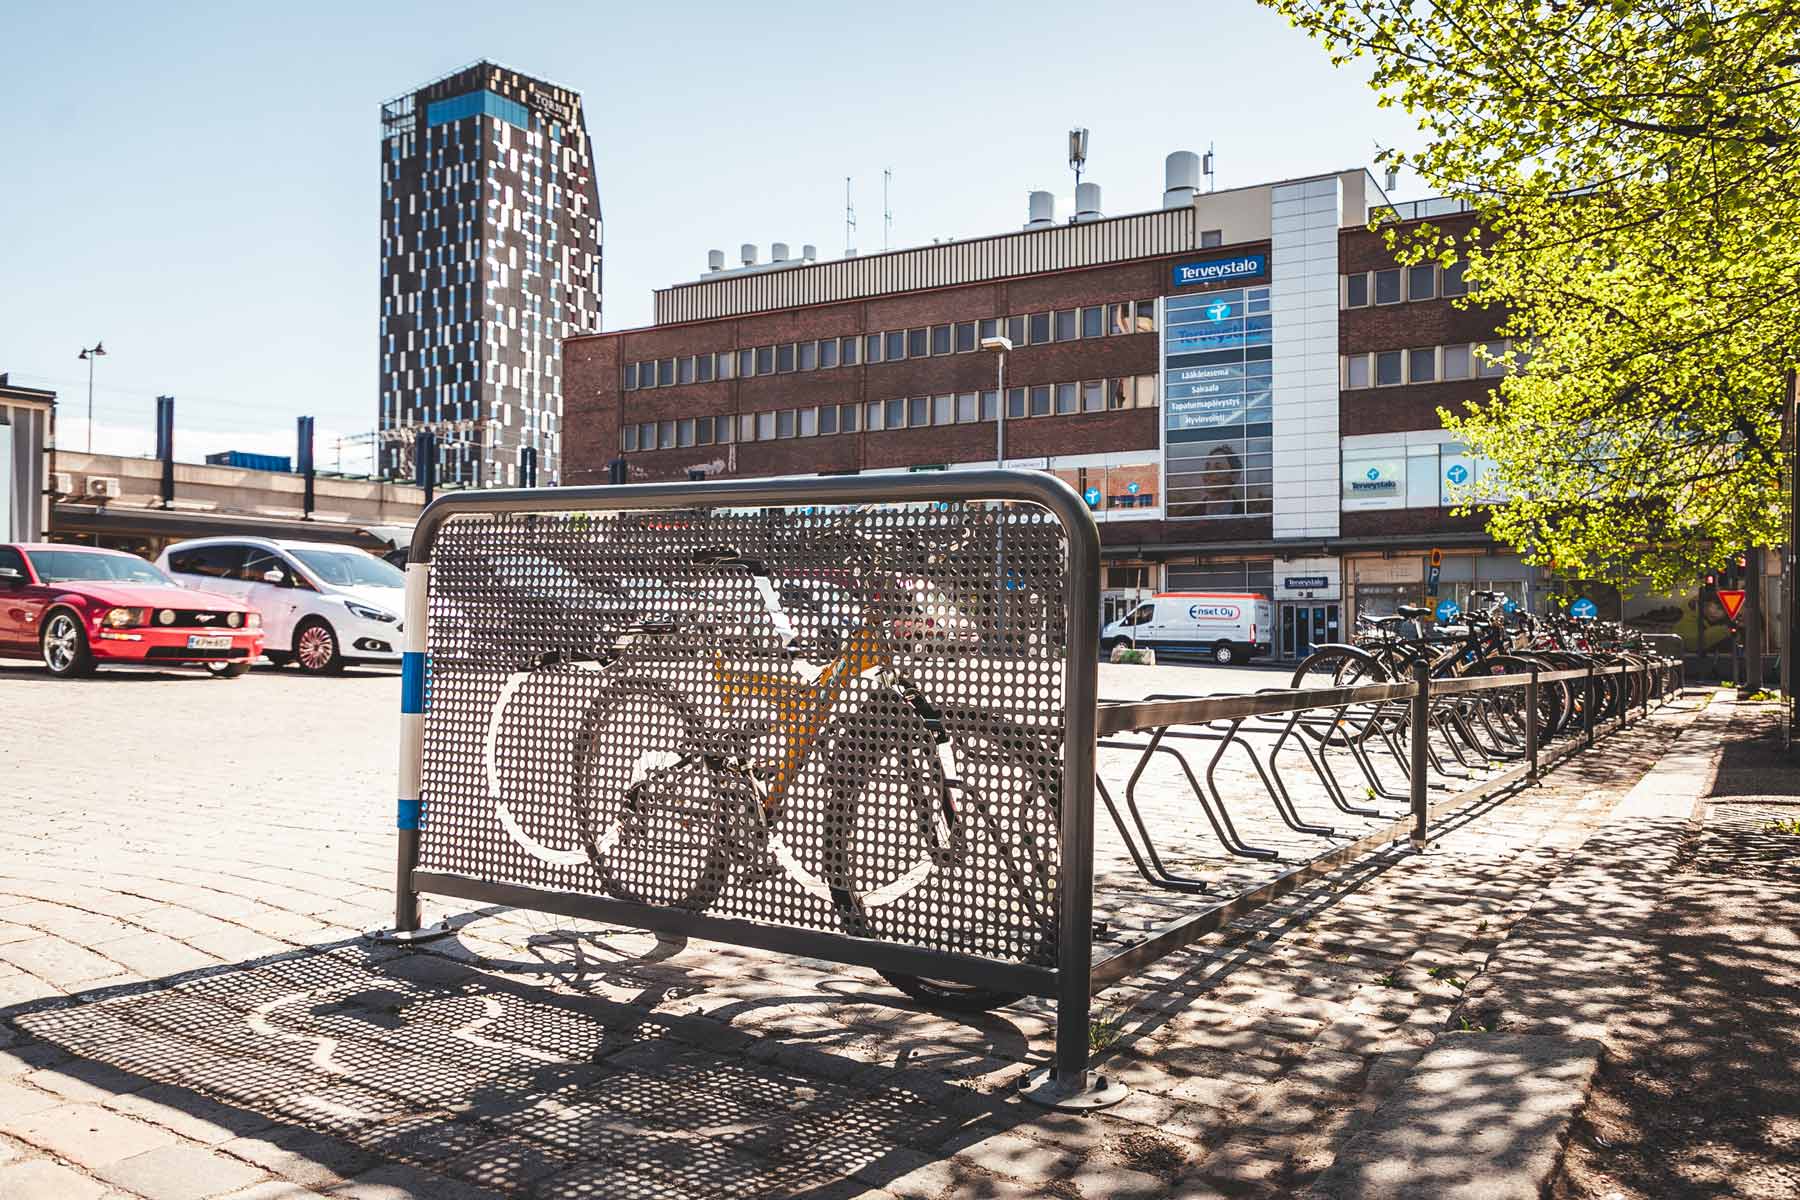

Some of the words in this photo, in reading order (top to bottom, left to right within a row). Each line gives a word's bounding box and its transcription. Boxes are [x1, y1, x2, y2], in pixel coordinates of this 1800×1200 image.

[1180, 259, 1257, 279] Terveystalo
[1191, 383, 1220, 394] Sairaala
[1352, 480, 1397, 490] Terveystalo
[1189, 604, 1217, 620] Enset
[1220, 607, 1233, 617] Oy
